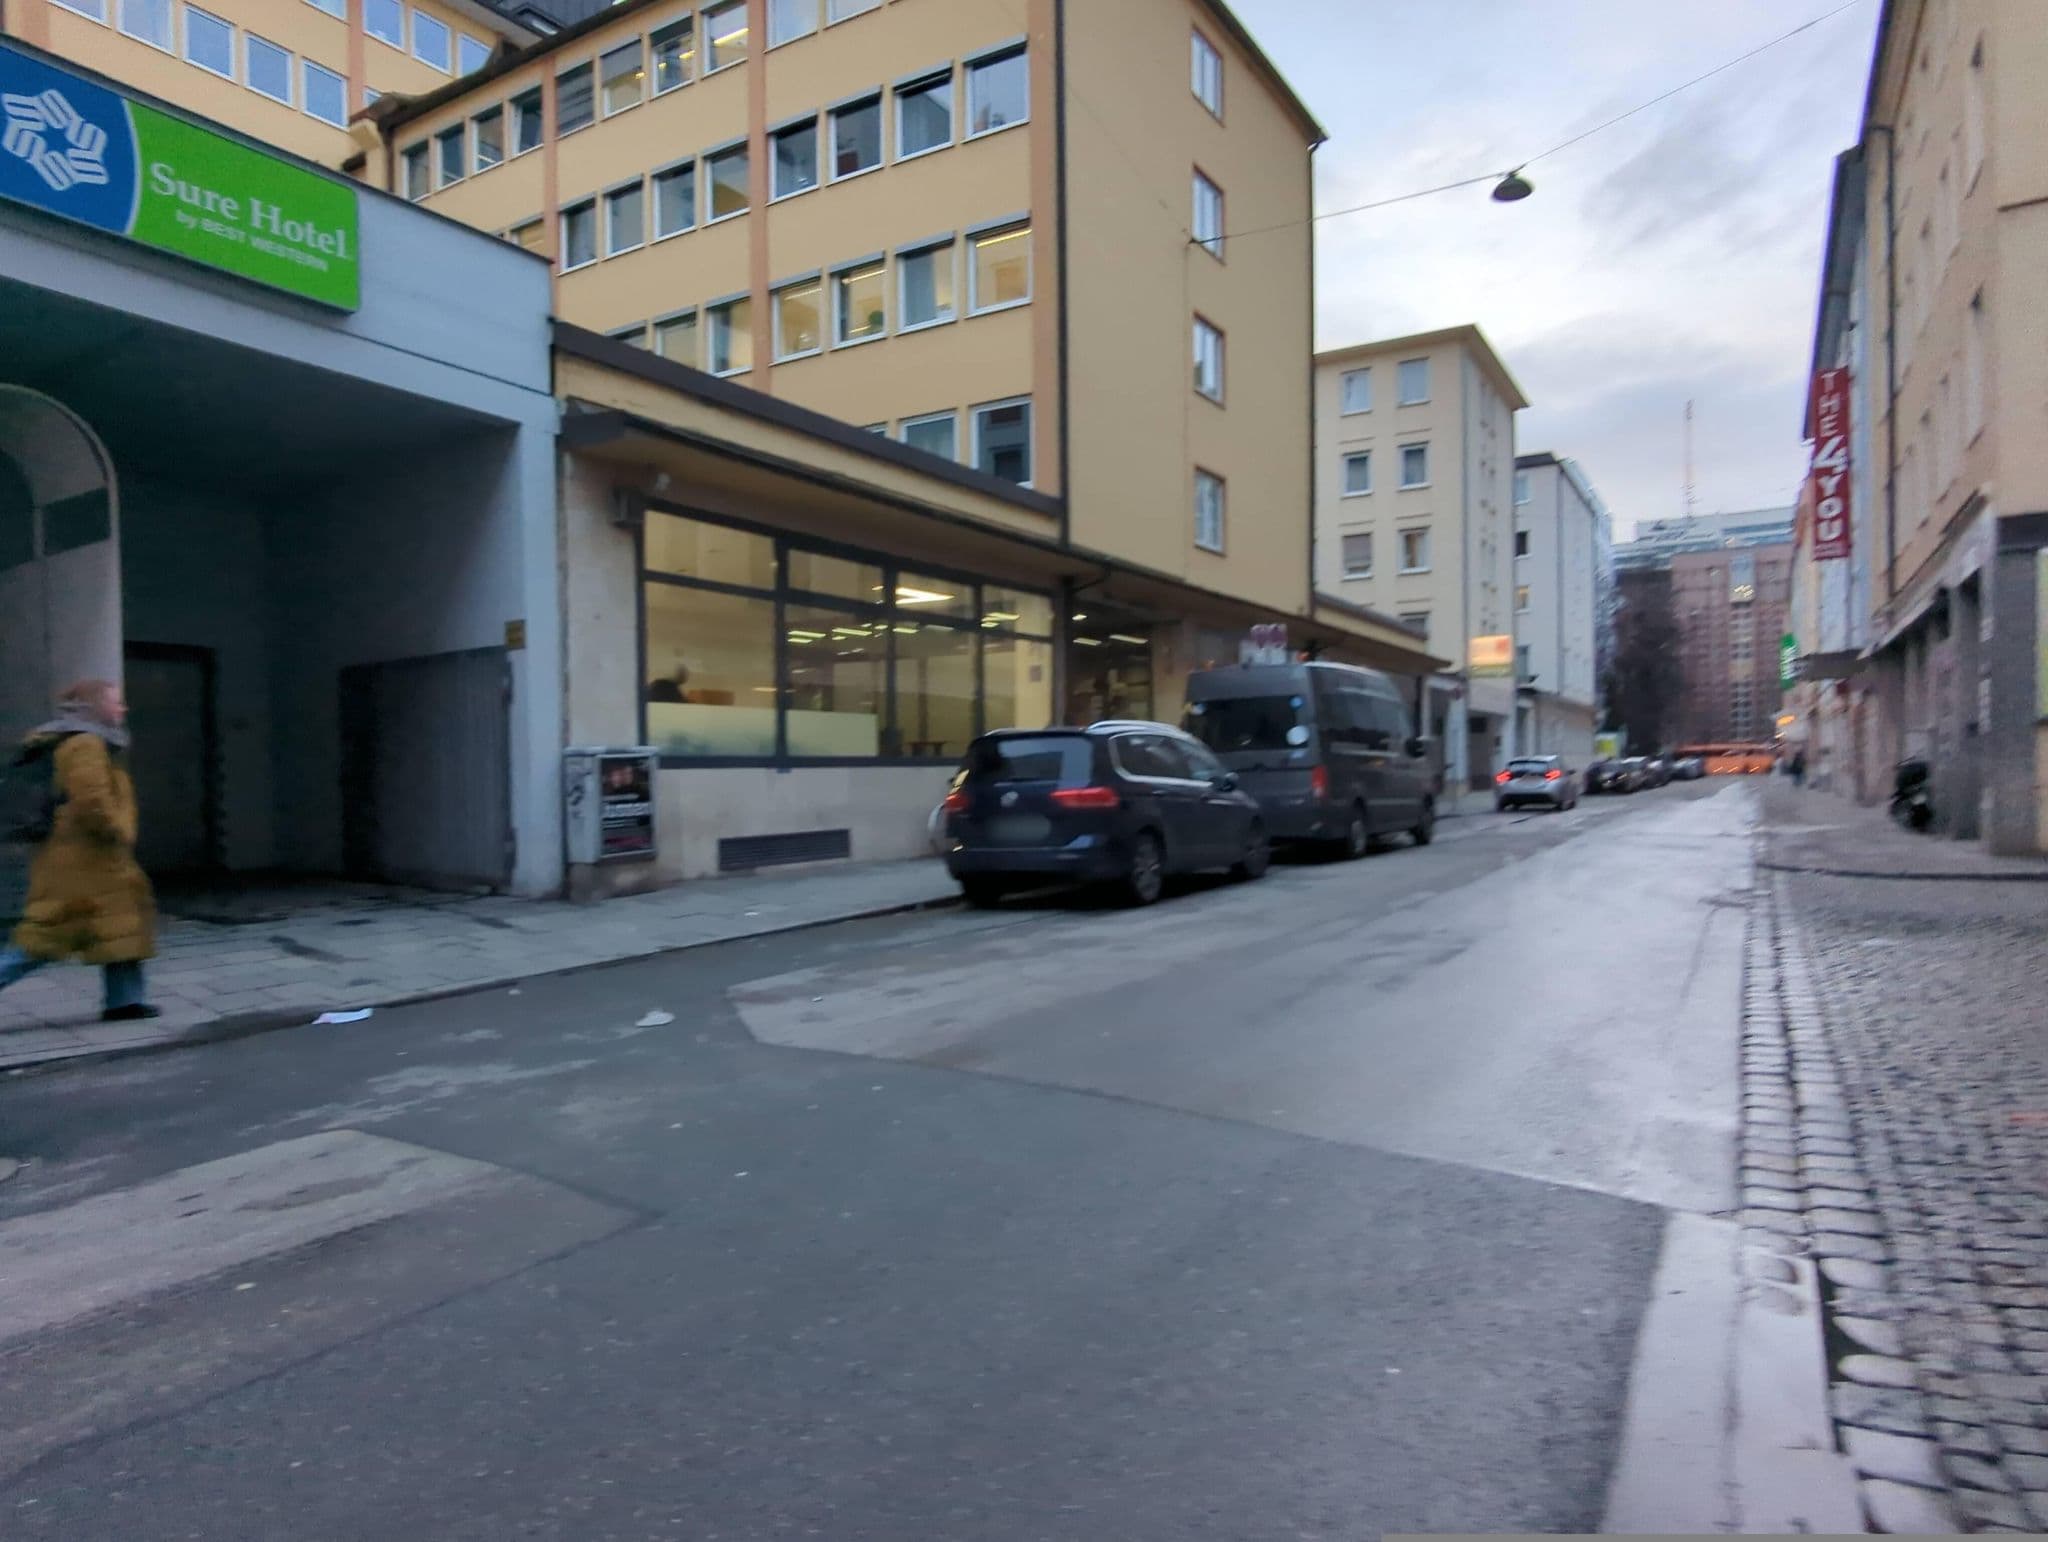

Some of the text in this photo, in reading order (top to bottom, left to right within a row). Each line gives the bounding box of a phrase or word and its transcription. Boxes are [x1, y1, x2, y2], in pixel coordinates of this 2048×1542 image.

[151, 162, 347, 259] Sure Hotel
[176, 210, 197, 229] by
[200, 217, 245, 243] BEST
